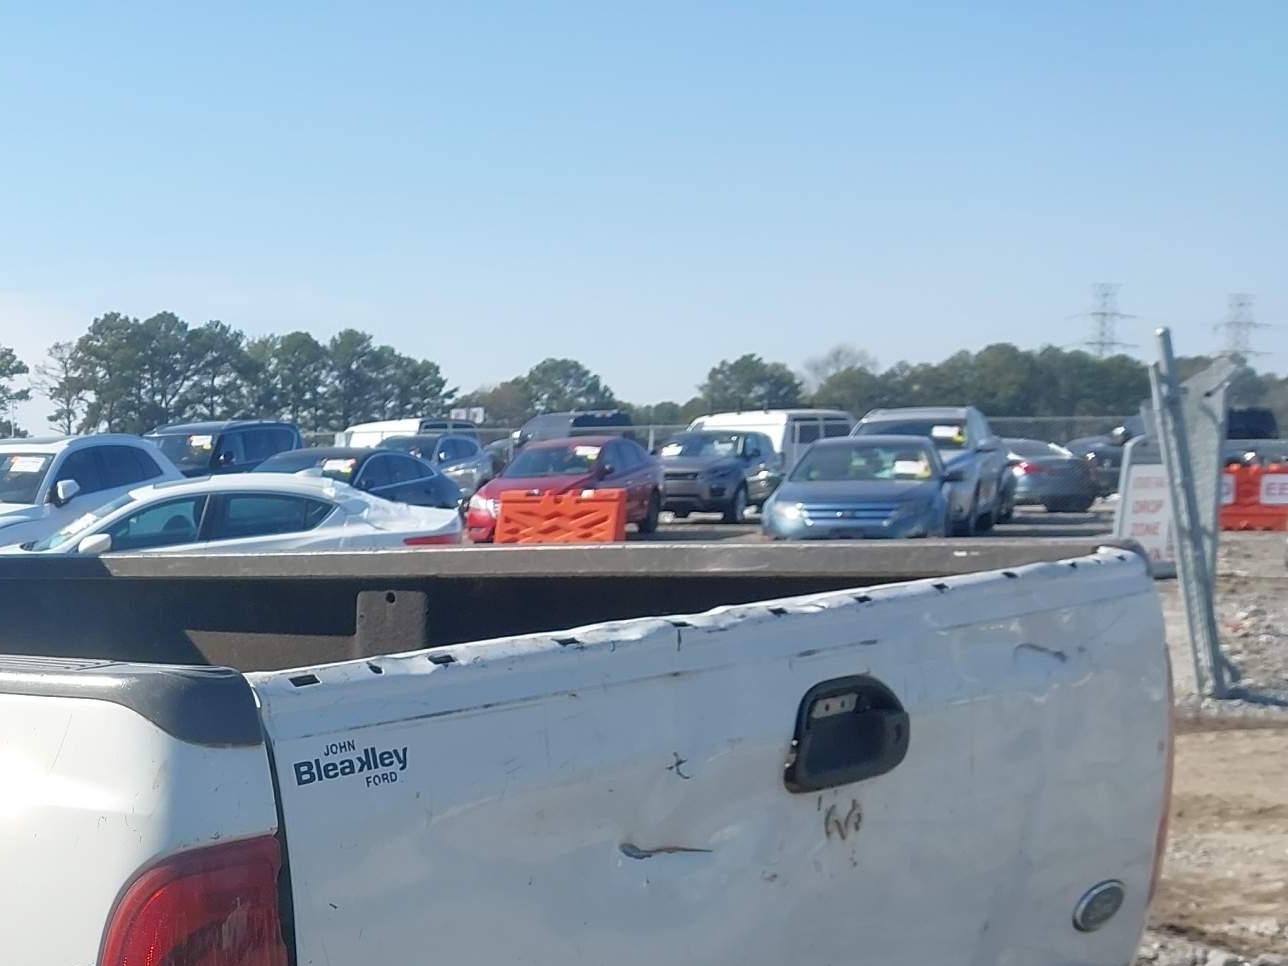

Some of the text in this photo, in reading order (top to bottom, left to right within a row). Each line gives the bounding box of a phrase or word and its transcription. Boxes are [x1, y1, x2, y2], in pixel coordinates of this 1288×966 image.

[324, 740, 356, 756] JOHN
[294, 747, 408, 786] Bleakley
[366, 772, 398, 788] FORD
